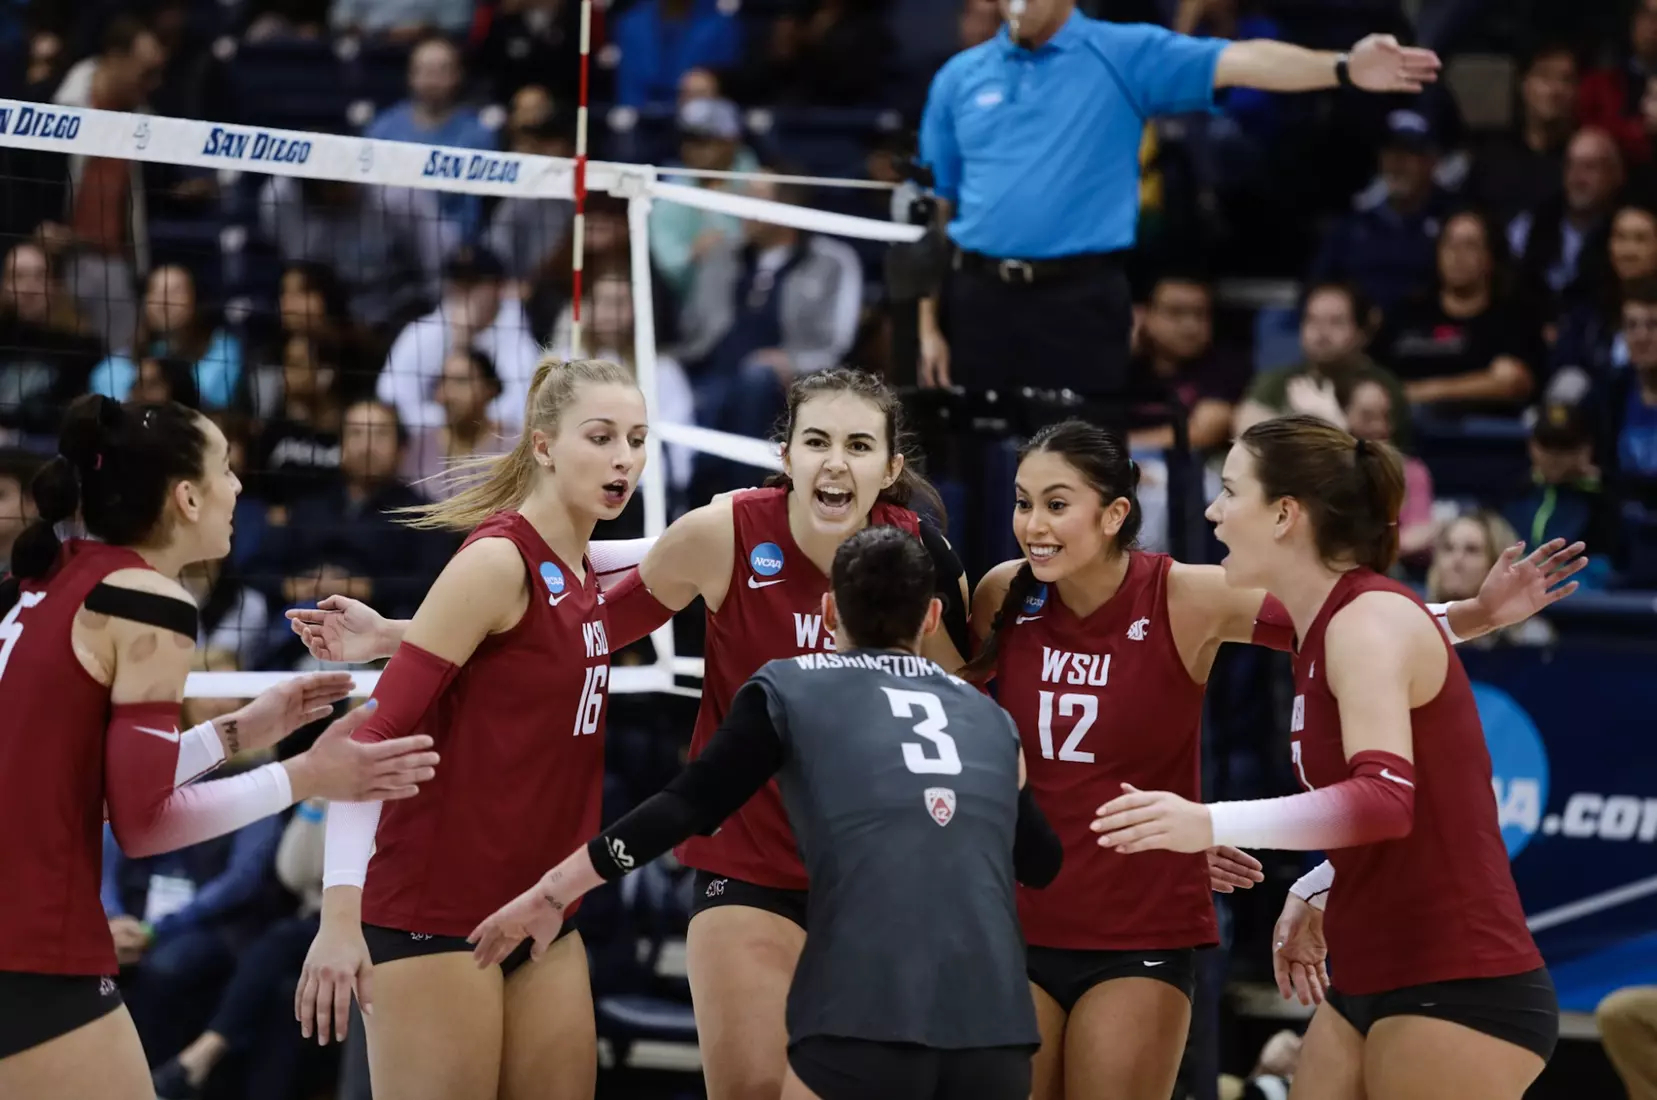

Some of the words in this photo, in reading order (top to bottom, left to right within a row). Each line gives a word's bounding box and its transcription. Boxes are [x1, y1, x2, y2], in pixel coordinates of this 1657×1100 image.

[12, 107, 81, 140] DIEGO
[202, 127, 250, 160] SAN
[250, 132, 312, 164] DIEGO
[423, 150, 464, 179] SAN
[754, 557, 782, 569] NCAA
[581, 620, 609, 658] WSU
[1041, 646, 1111, 686] WSU
[572, 664, 608, 737] 16
[880, 686, 962, 775] 3
[1038, 690, 1098, 763] 12
